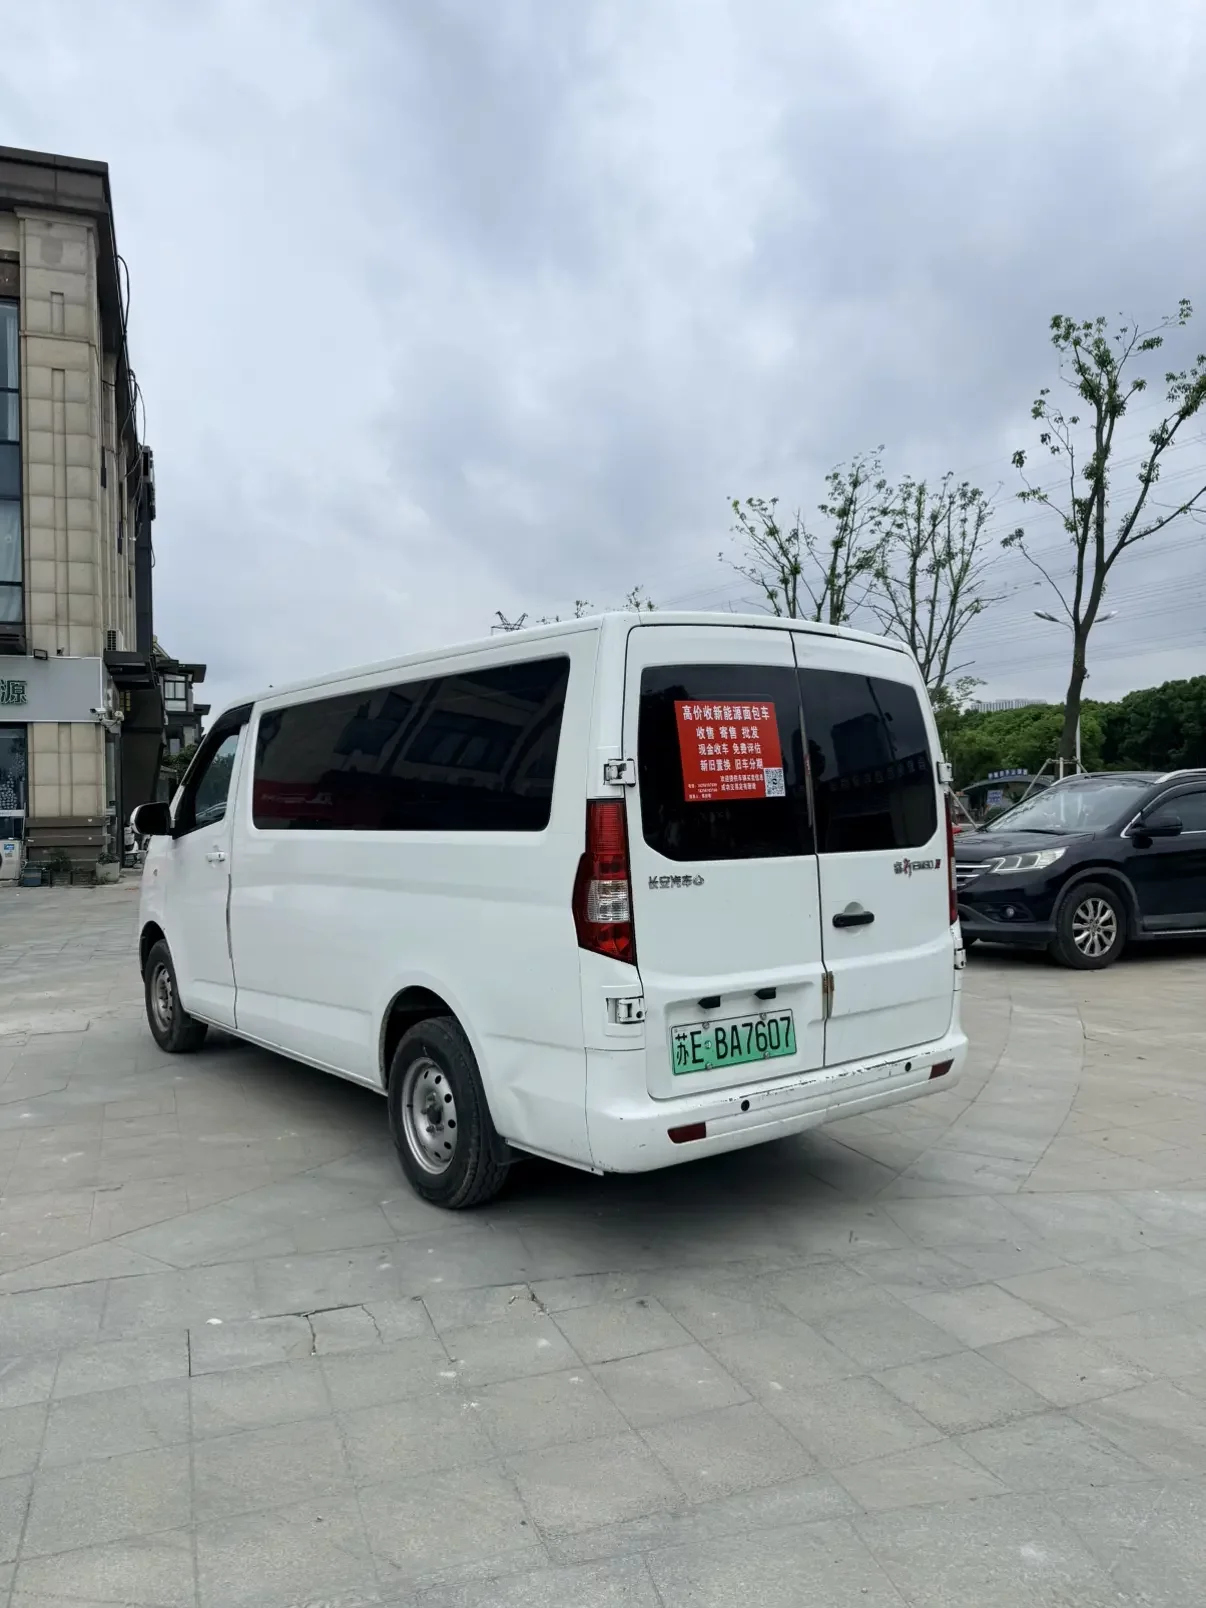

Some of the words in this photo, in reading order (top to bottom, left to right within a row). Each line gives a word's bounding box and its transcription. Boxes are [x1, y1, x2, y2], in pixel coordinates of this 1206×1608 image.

[0, 680, 27, 704] 源
[682, 704, 770, 720] 高价收新能源面包车
[696, 726, 714, 740] 收售
[719, 726, 737, 739] 寄售
[741, 726, 759, 739] 批发
[698, 743, 729, 756] 现金收车
[732, 742, 762, 755] 免费评估
[700, 759, 731, 771] 新旧置换
[734, 758, 764, 770] 旧车分期
[648, 875, 692, 889] 长安汽车
[715, 1016, 791, 1060] BA7607
